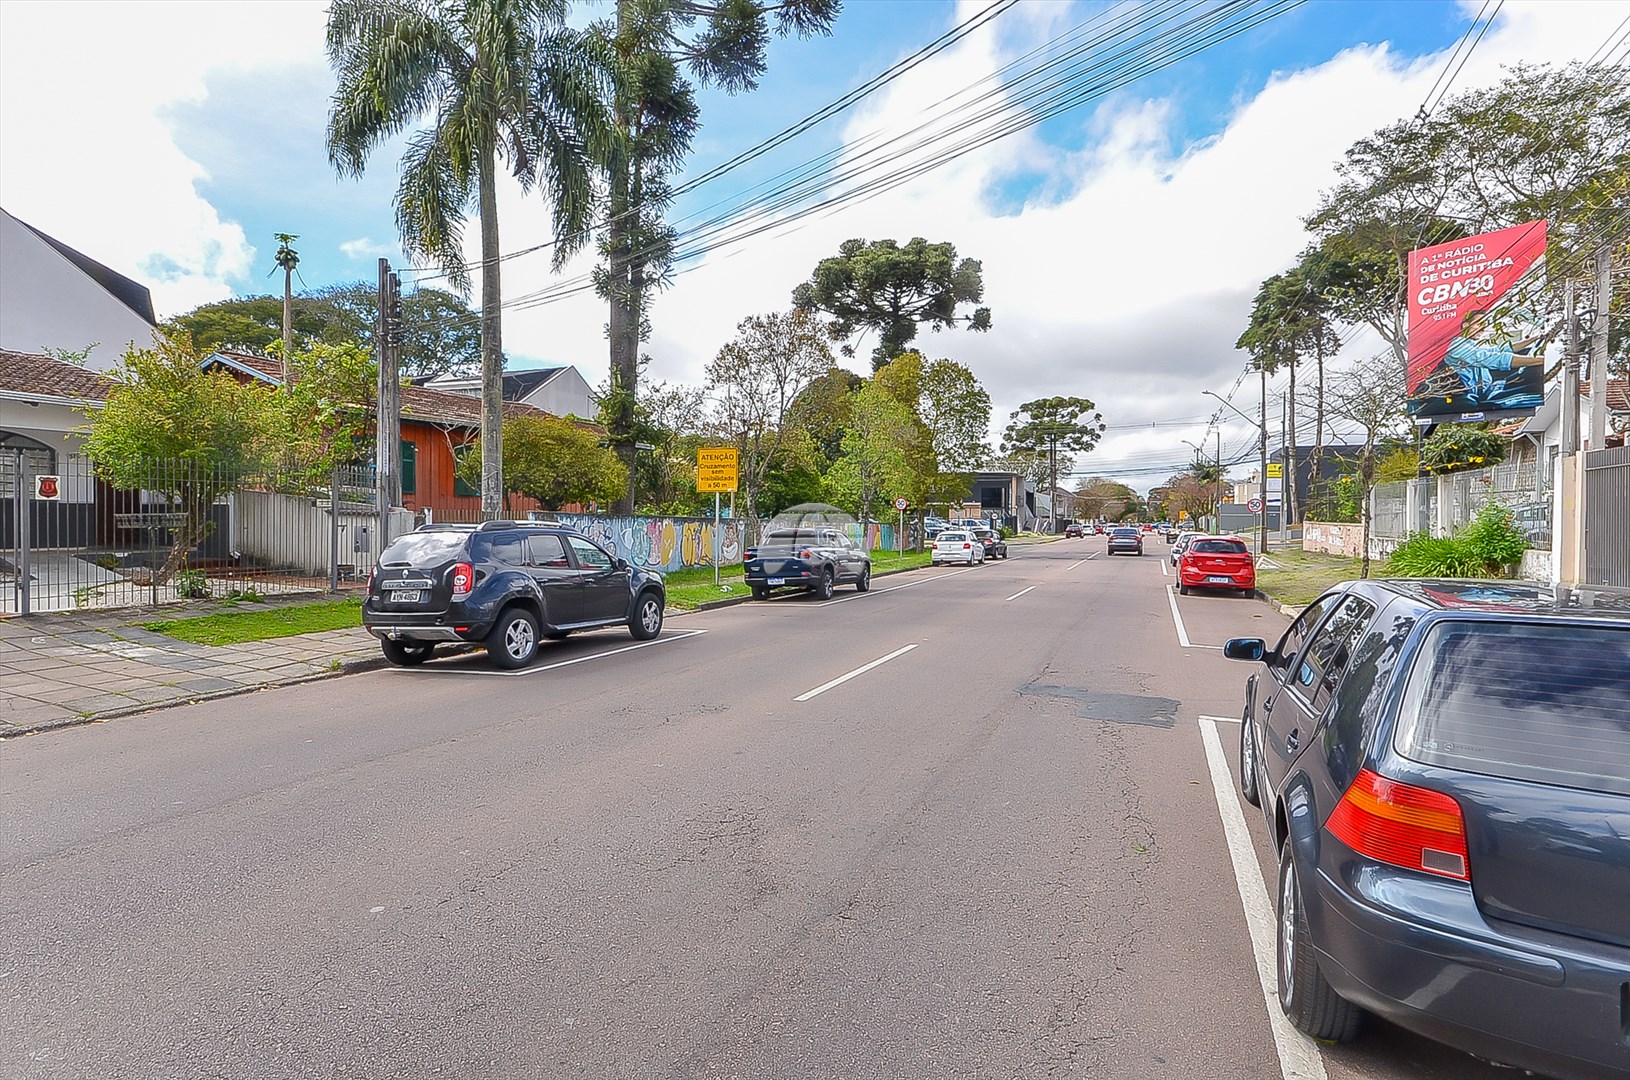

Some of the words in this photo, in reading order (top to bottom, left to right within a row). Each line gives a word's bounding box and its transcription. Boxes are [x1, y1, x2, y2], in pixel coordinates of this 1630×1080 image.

[1420, 257, 1429, 265] A
[1444, 243, 1484, 258] RÁDIO
[1420, 265, 1435, 274] DE
[1438, 253, 1487, 269] NOTÍCIA
[1420, 274, 1438, 284] DE
[1441, 257, 1514, 279] CURITIBA
[701, 453, 735, 461] ATENÇÃO
[897, 500, 905, 508] 50
